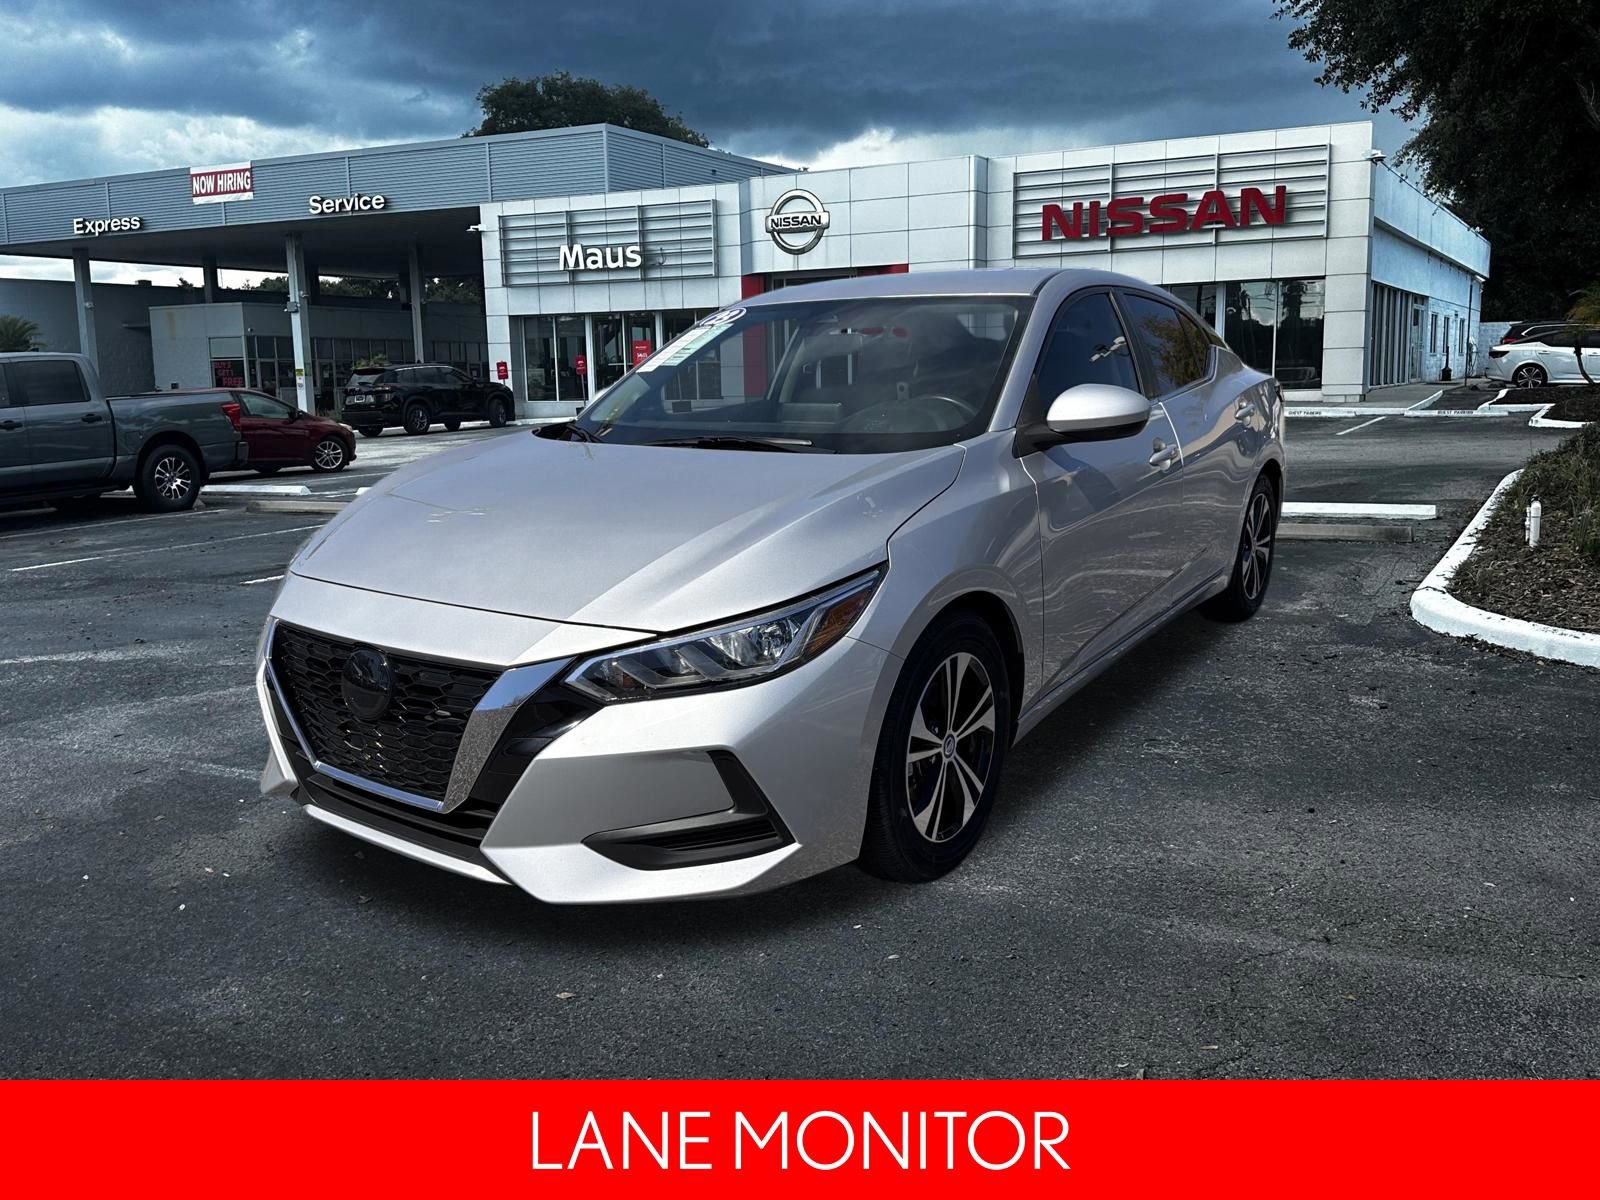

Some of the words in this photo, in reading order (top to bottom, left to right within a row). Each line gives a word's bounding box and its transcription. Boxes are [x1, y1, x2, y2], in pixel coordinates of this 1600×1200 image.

[192, 174, 216, 195] NOW
[217, 171, 251, 192] HIRING
[308, 193, 385, 215] Service
[1042, 185, 1287, 241] NISSAN
[73, 216, 141, 237] Express
[770, 214, 822, 229] NISSAN
[559, 243, 642, 271] Maus
